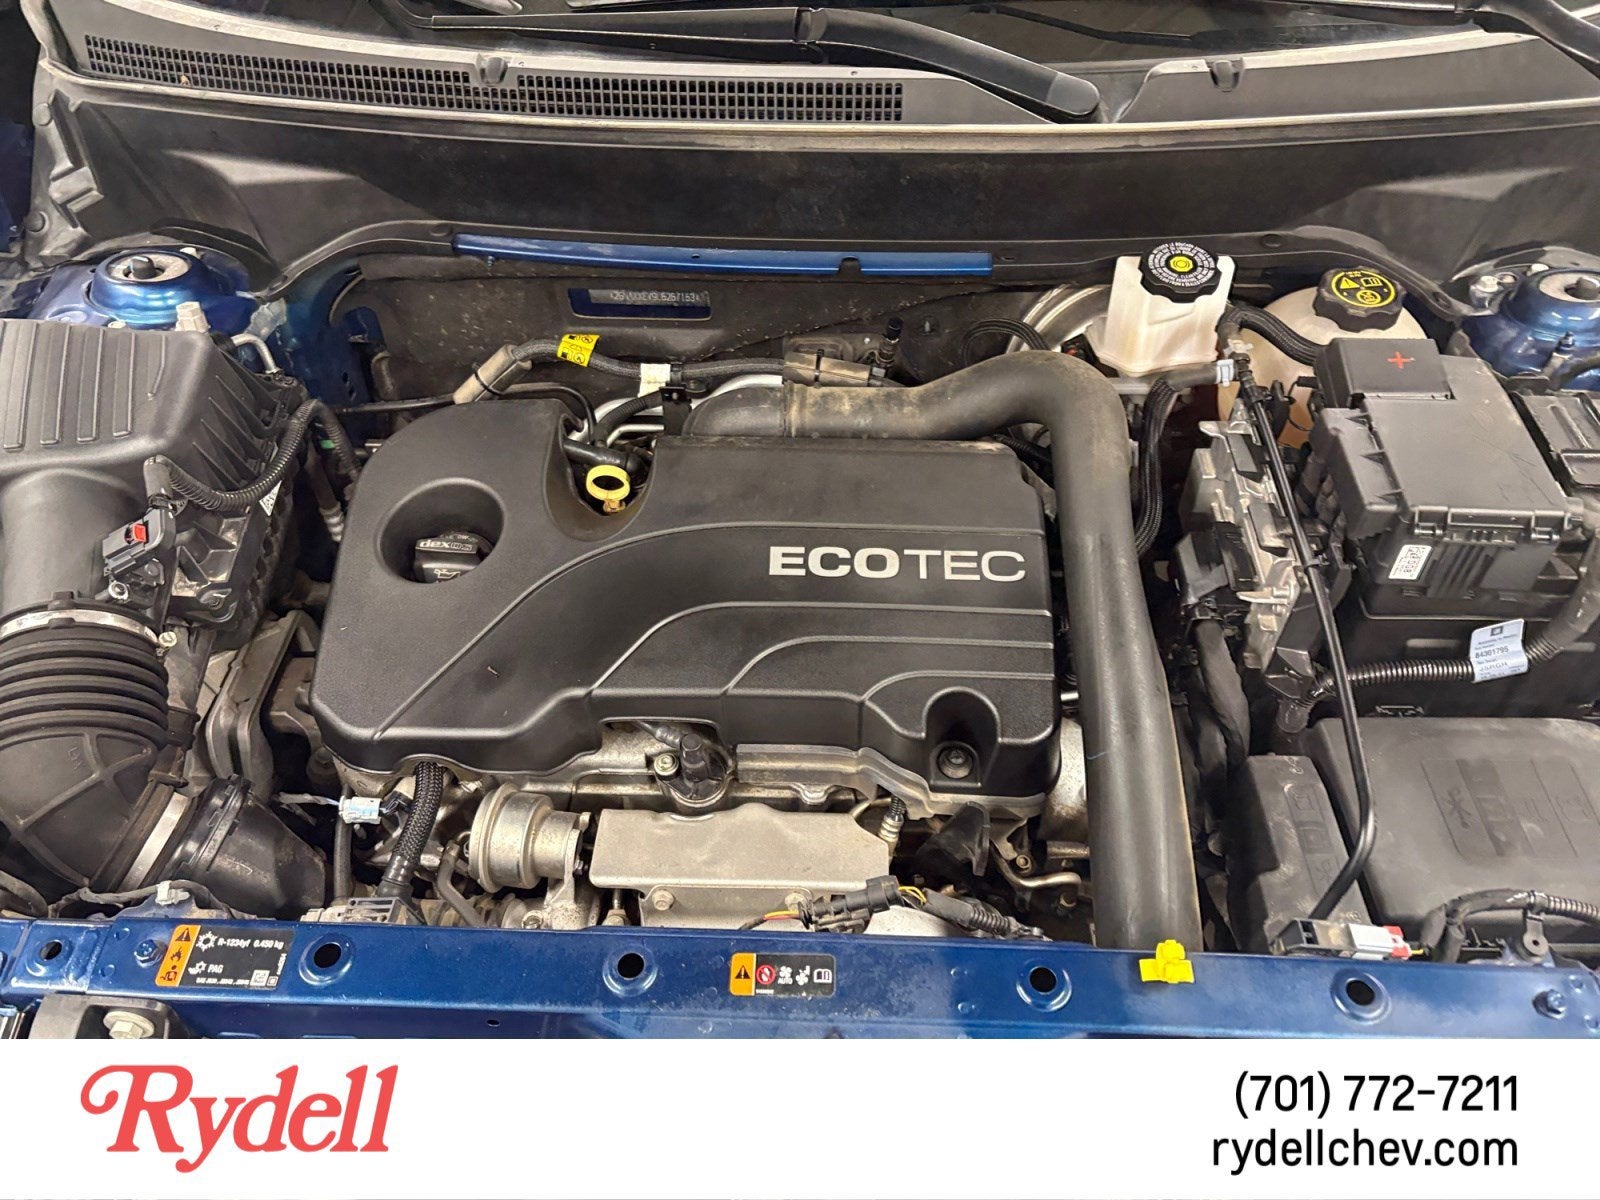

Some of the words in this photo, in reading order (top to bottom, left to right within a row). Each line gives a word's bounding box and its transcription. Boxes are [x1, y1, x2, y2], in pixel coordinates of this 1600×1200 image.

[420, 540, 472, 551] dexos
[769, 546, 1026, 582] ECOTEC
[217, 937, 251, 949] R-1234yf
[273, 940, 285, 950] kg
[207, 964, 224, 974] PAG
[777, 977, 794, 985] AUTO
